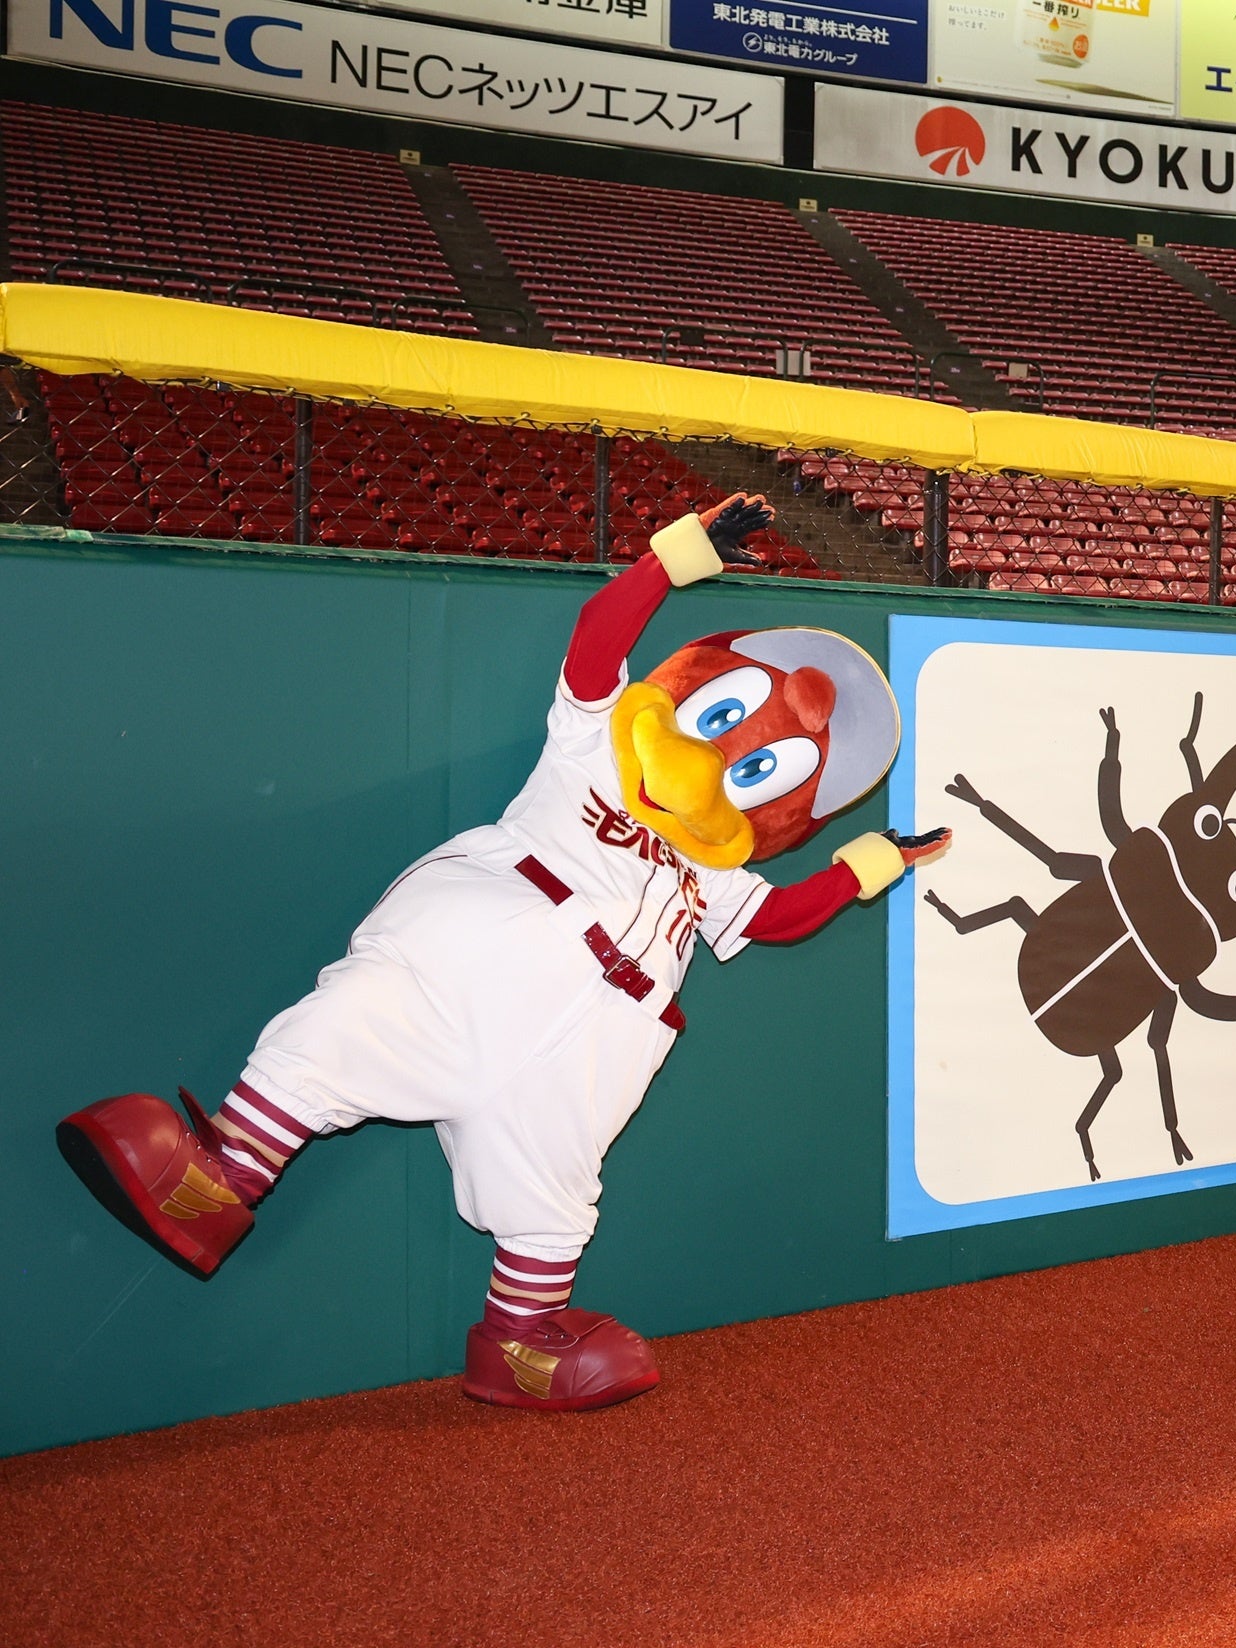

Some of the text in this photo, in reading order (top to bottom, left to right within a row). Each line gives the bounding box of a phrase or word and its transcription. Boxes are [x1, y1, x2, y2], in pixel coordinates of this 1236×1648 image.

[50, 0, 303, 79] NEC
[712, 2, 890, 46] 東北発電工業株式会社
[763, 41, 858, 66] 東北電力グループ
[329, 39, 755, 141] NECネッツエスアイ
